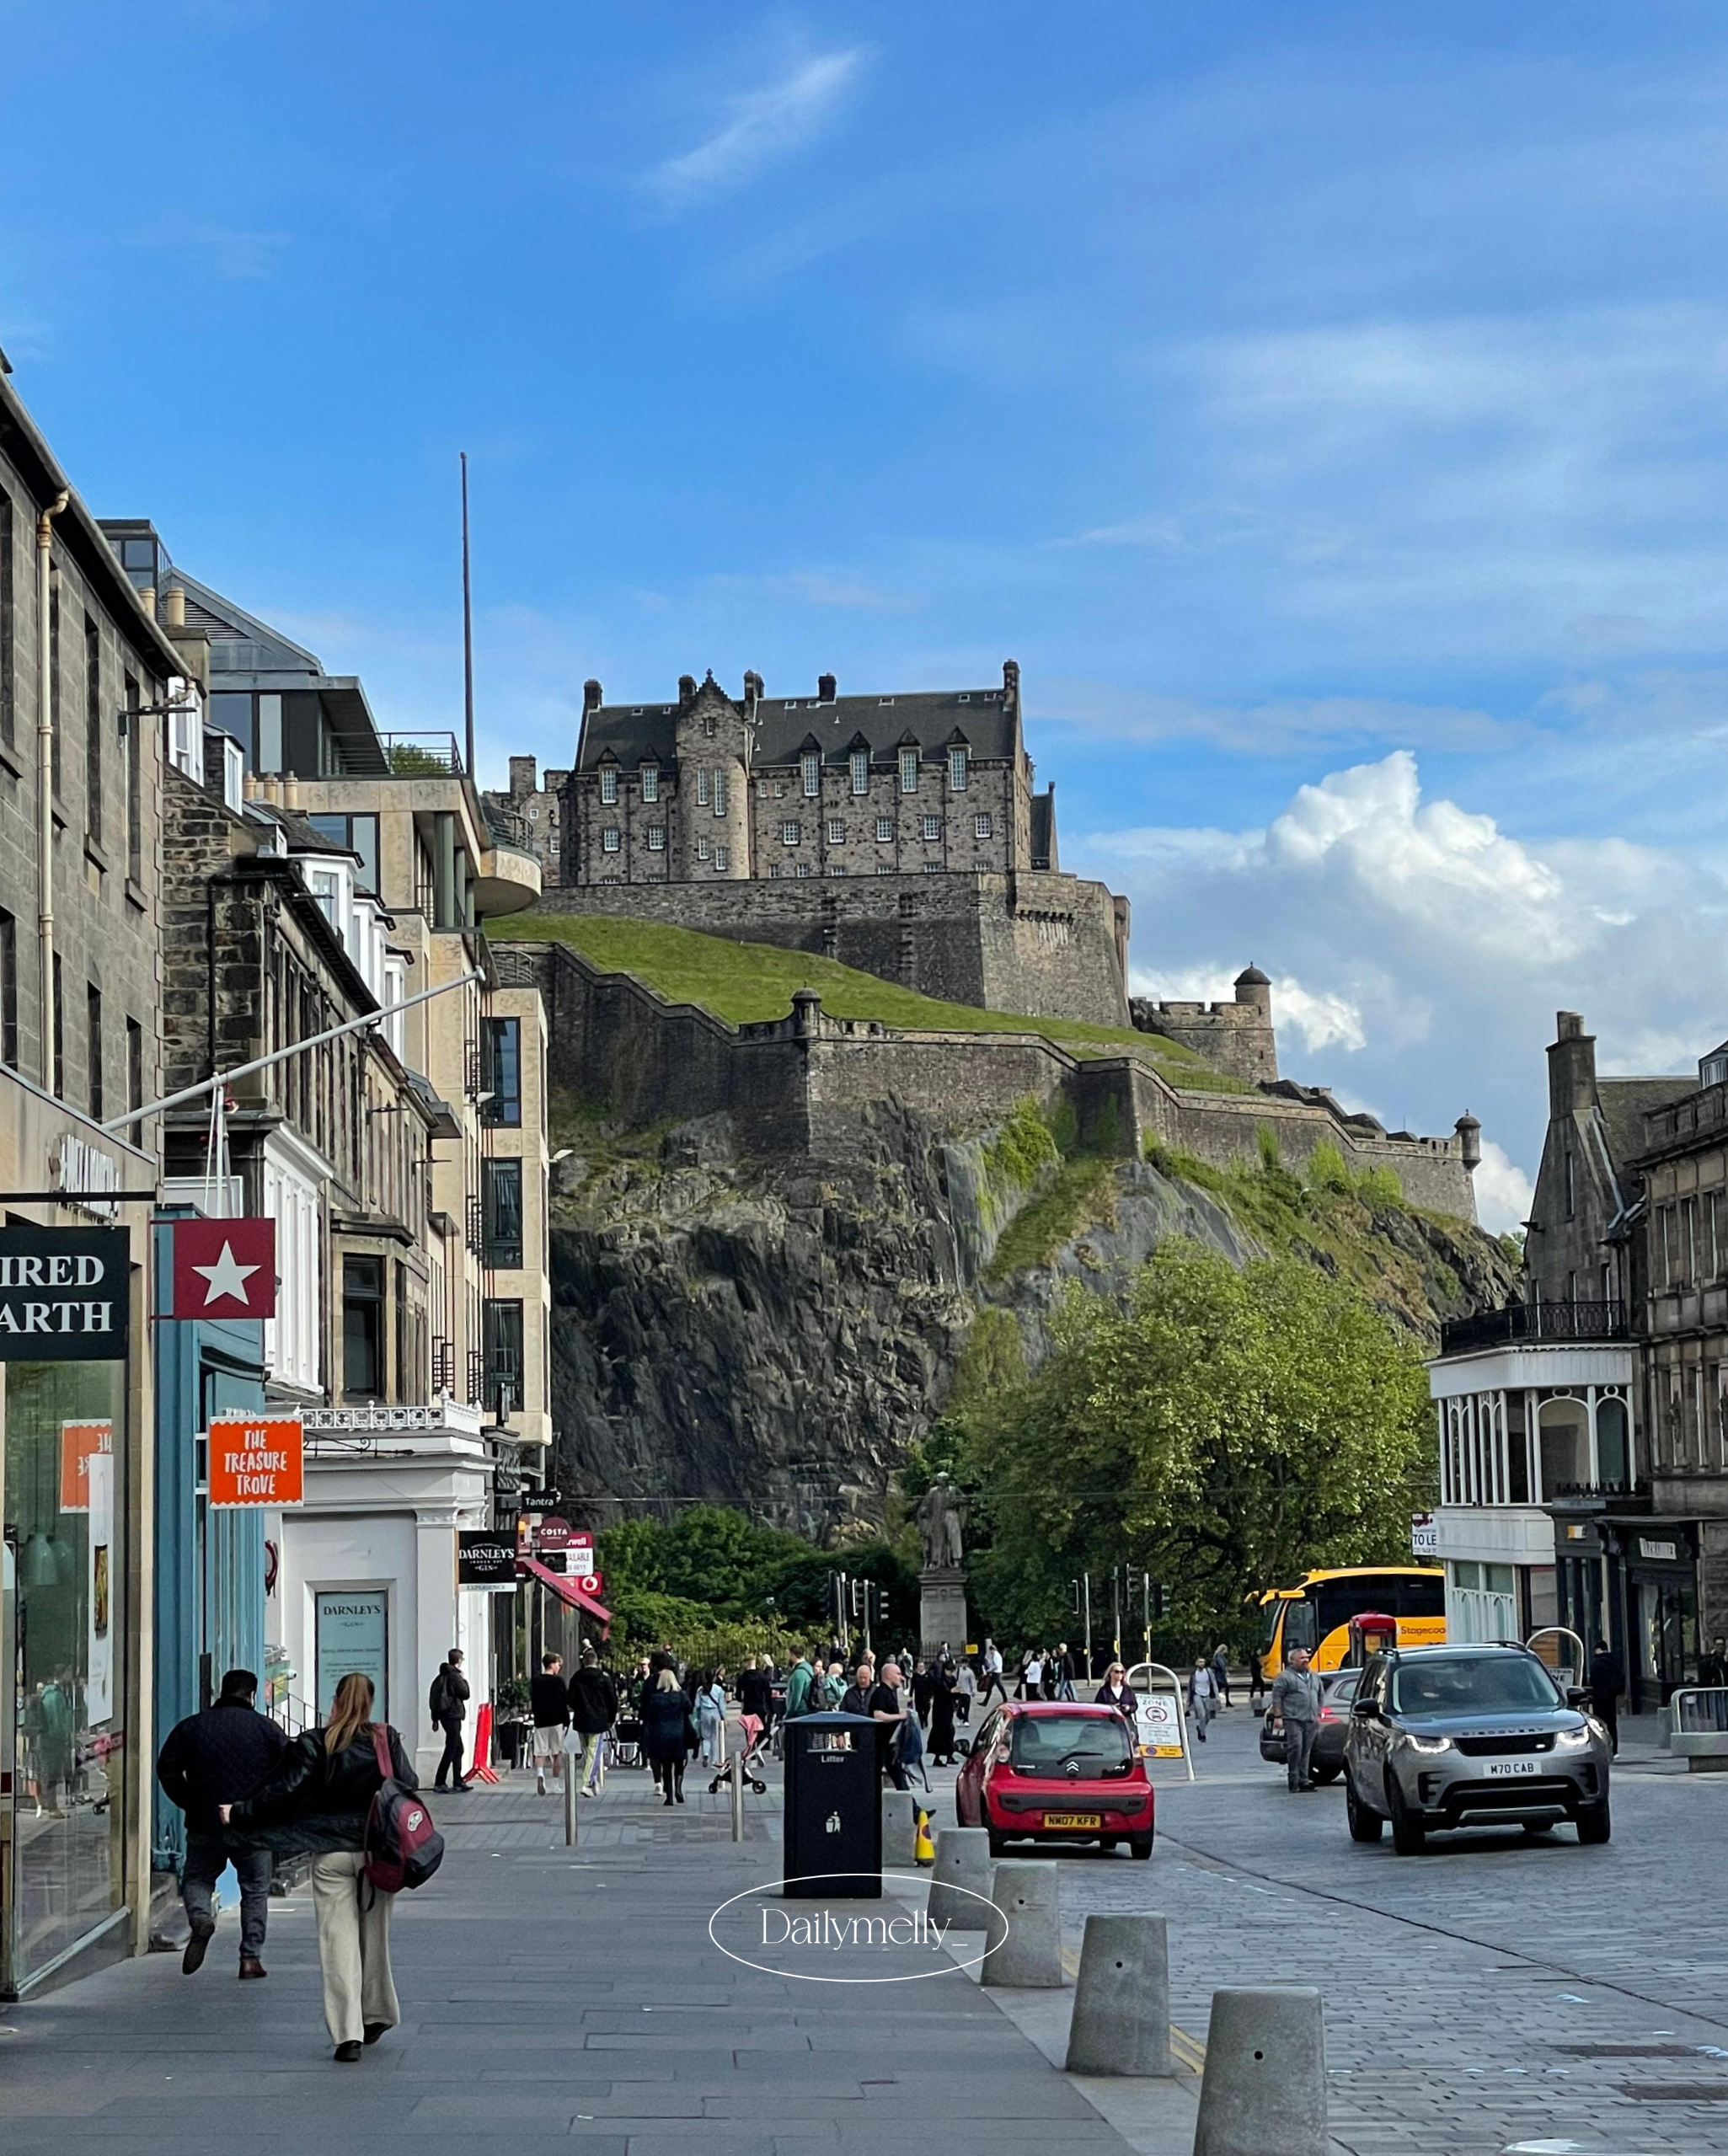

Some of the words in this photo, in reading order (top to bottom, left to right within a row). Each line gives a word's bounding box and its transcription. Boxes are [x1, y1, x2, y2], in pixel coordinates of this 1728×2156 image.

[0, 1255, 104, 1287] IRED
[0, 1302, 114, 1333] ARTH
[244, 1430, 267, 1450] THE
[224, 1451, 287, 1473] TREASURE
[236, 1474, 276, 1495] TROVE
[525, 1498, 554, 1506] Tantra
[1413, 1534, 1425, 1545] TO
[1426, 1534, 1436, 1545] LE
[458, 1549, 515, 1559] DARNLEY'S
[1401, 1626, 1447, 1636] Stagecoa
[821, 1755, 845, 1763] Litter
[1514, 1763, 1534, 1773] CAB
[1077, 1816, 1097, 1826] KFR
